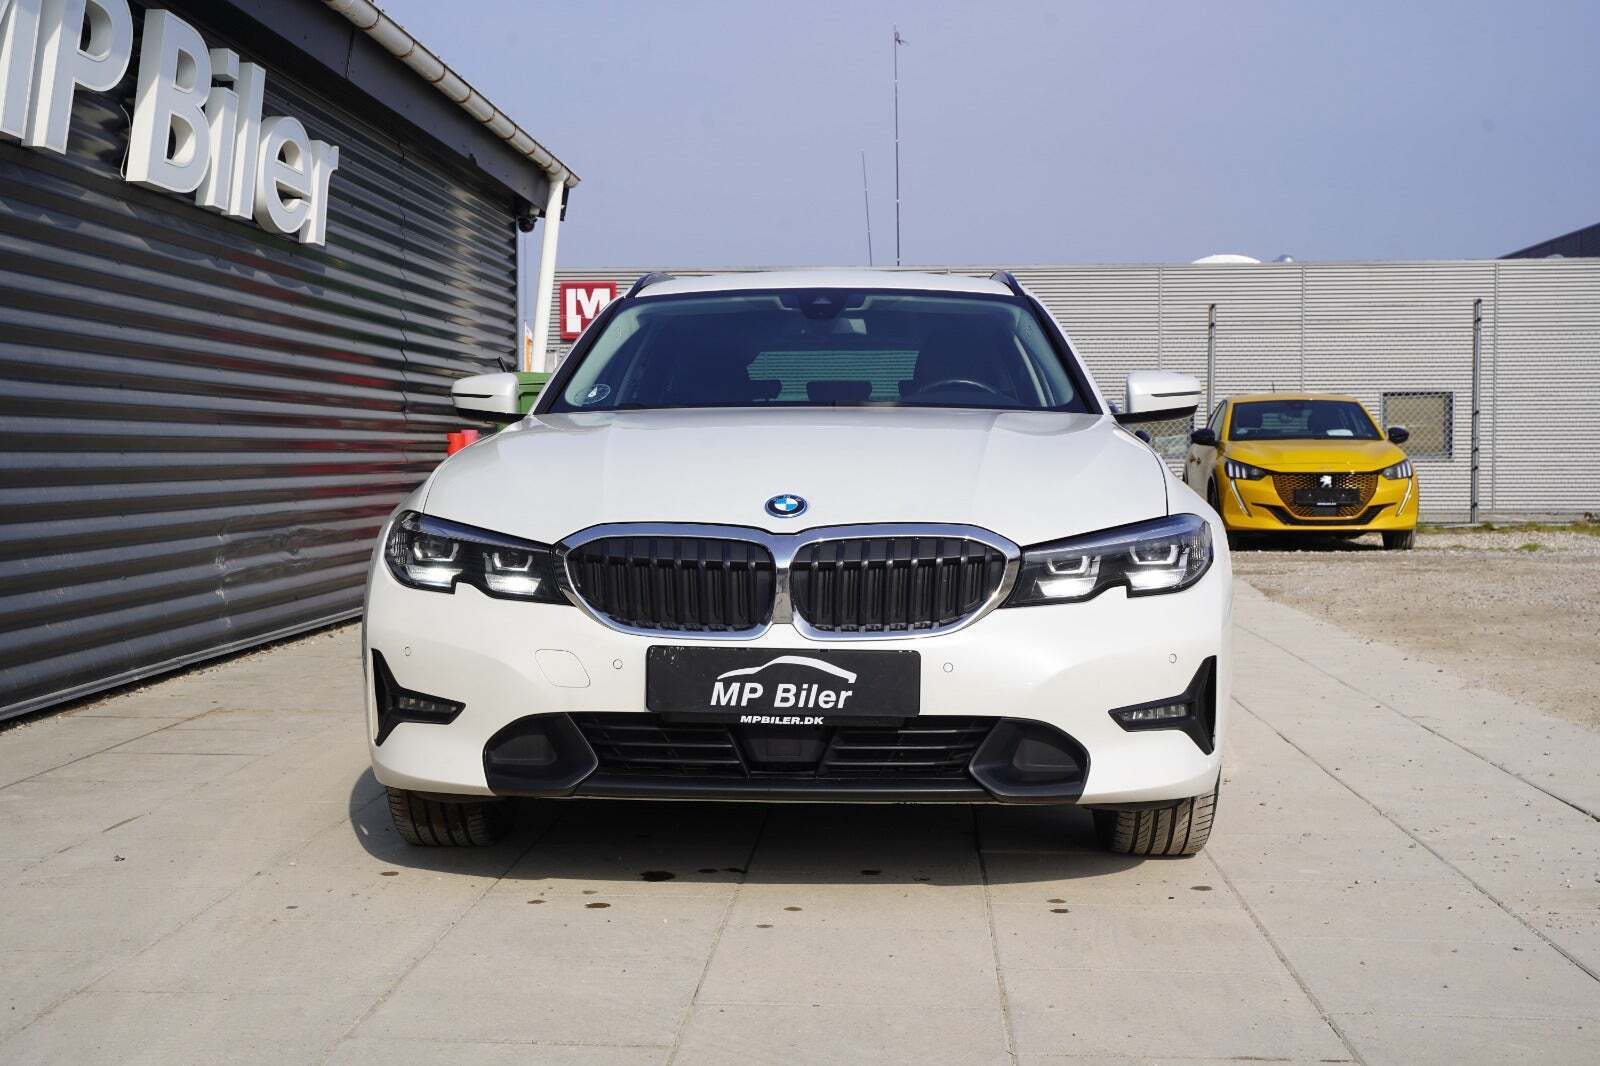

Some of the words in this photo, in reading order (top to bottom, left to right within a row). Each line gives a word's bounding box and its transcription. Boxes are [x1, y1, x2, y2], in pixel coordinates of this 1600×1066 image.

[126, 9, 339, 246] Biler
[710, 681, 764, 707] MP
[773, 683, 853, 709] Biler
[740, 715, 825, 725] MPBILER.DK
